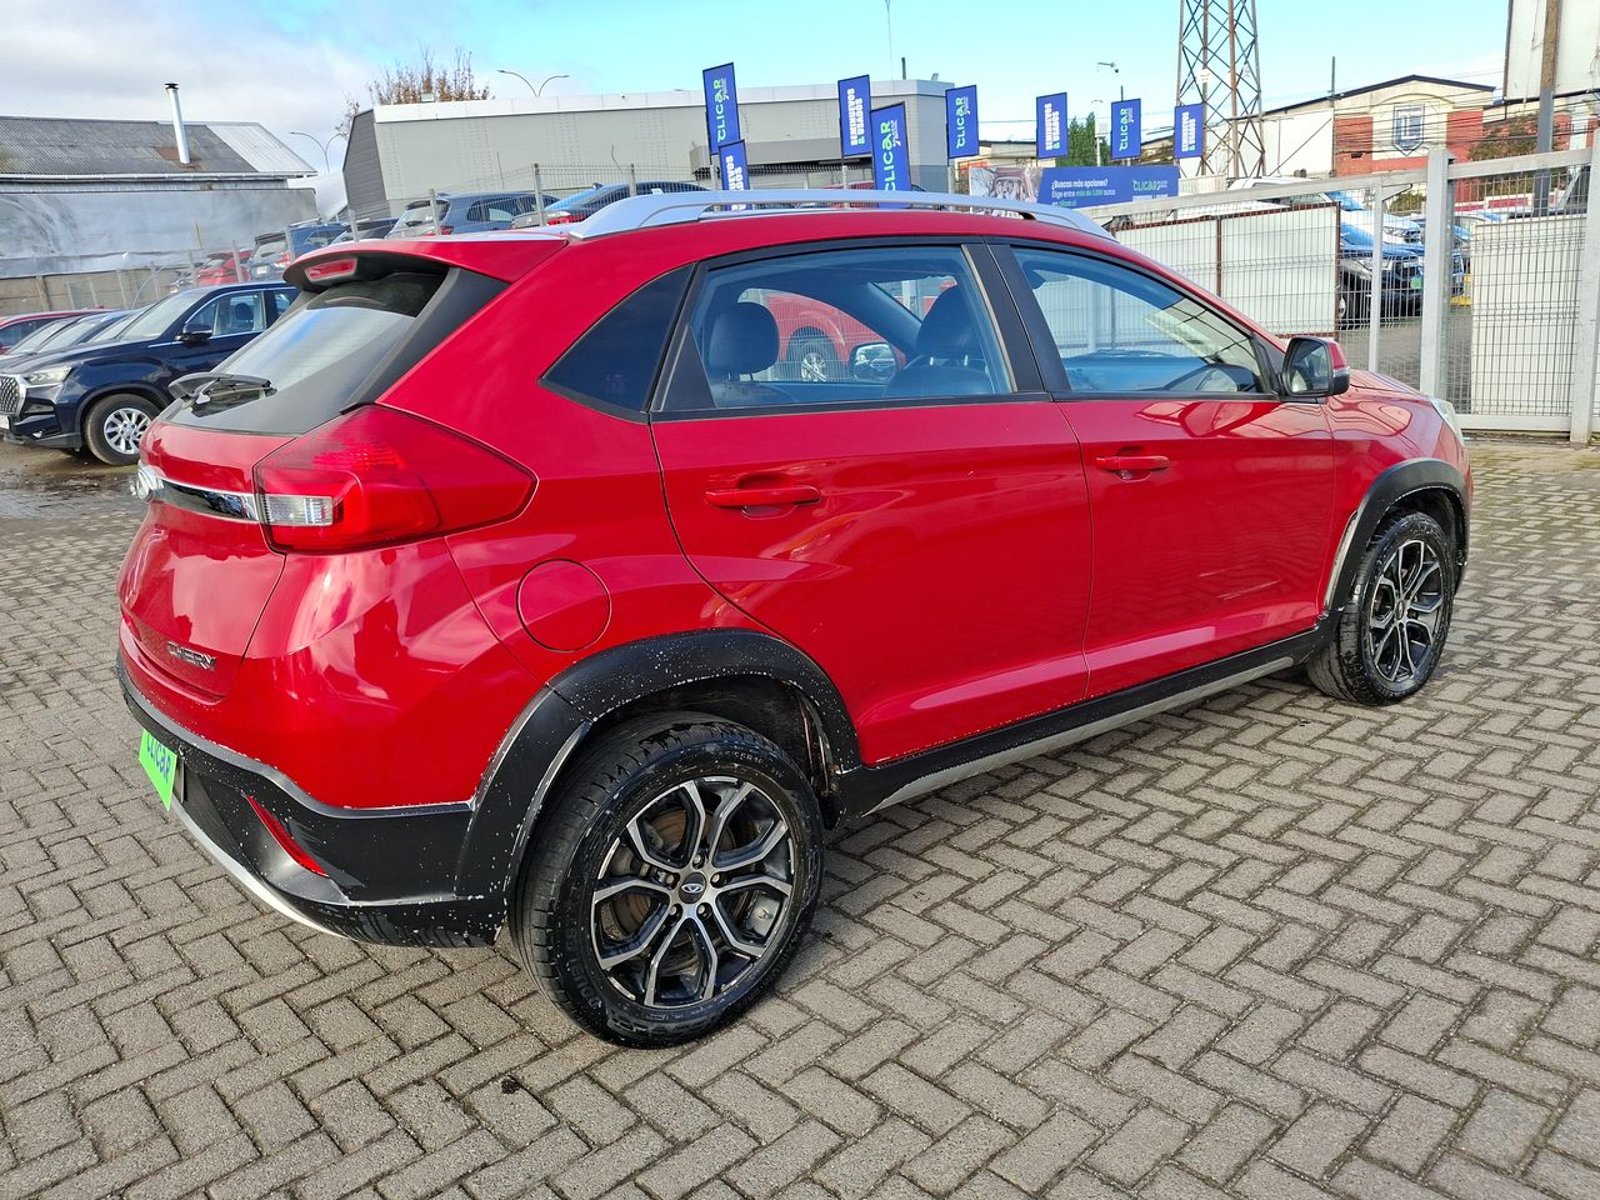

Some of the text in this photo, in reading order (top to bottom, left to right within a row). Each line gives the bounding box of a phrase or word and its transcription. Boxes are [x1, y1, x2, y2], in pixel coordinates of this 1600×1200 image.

[713, 79, 727, 143] CLICAR
[955, 97, 966, 149] CLICAR
[1119, 108, 1129, 151] CLICAR
[167, 640, 216, 671] CHERY
